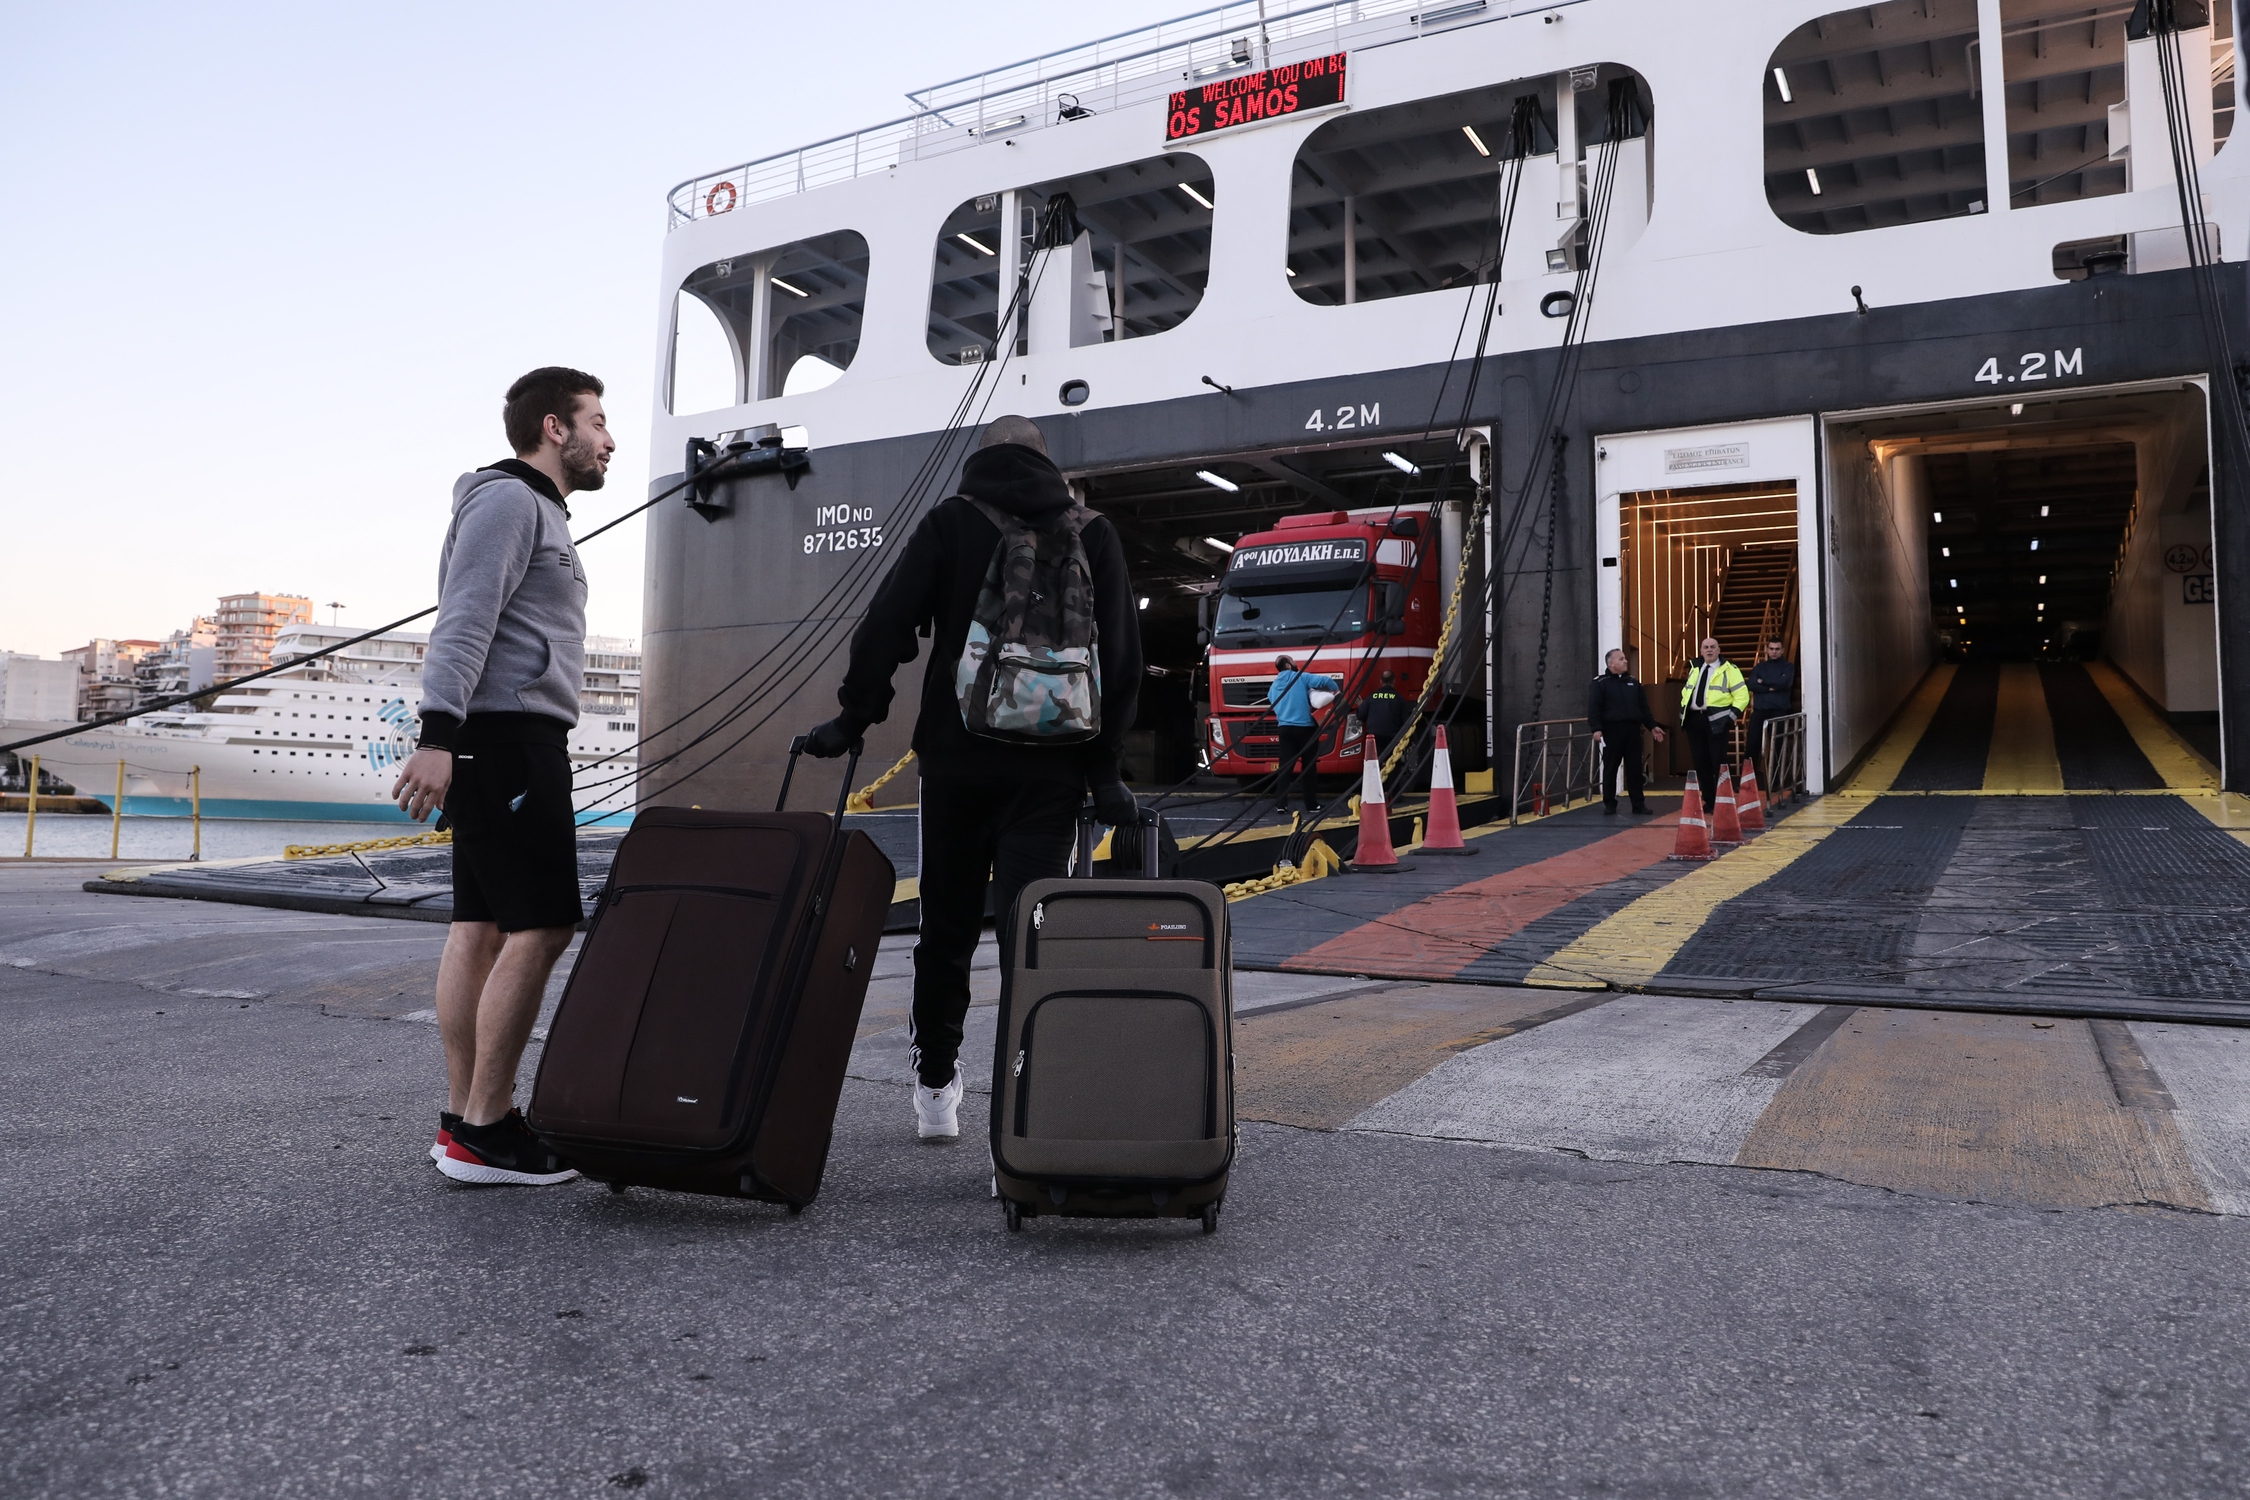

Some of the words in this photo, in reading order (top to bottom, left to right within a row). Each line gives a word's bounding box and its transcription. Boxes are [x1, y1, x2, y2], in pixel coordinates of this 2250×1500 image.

[1168, 91, 1186, 111] YS
[1202, 71, 1268, 104] WELCOME
[1272, 63, 1300, 87] YOU
[1303, 57, 1325, 80] ON
[1166, 106, 1200, 138] OS
[1214, 84, 1299, 129] SAMOS
[1974, 347, 2083, 385] 4.2M
[1305, 402, 1380, 432] 4.2M
[816, 503, 850, 527] IMO
[803, 526, 883, 554] 8712635
[1257, 544, 1333, 566] ΛΙΟΥΔΑΚΗ
[65, 737, 116, 751] Celestyal
[118, 741, 168, 754] Olympia
